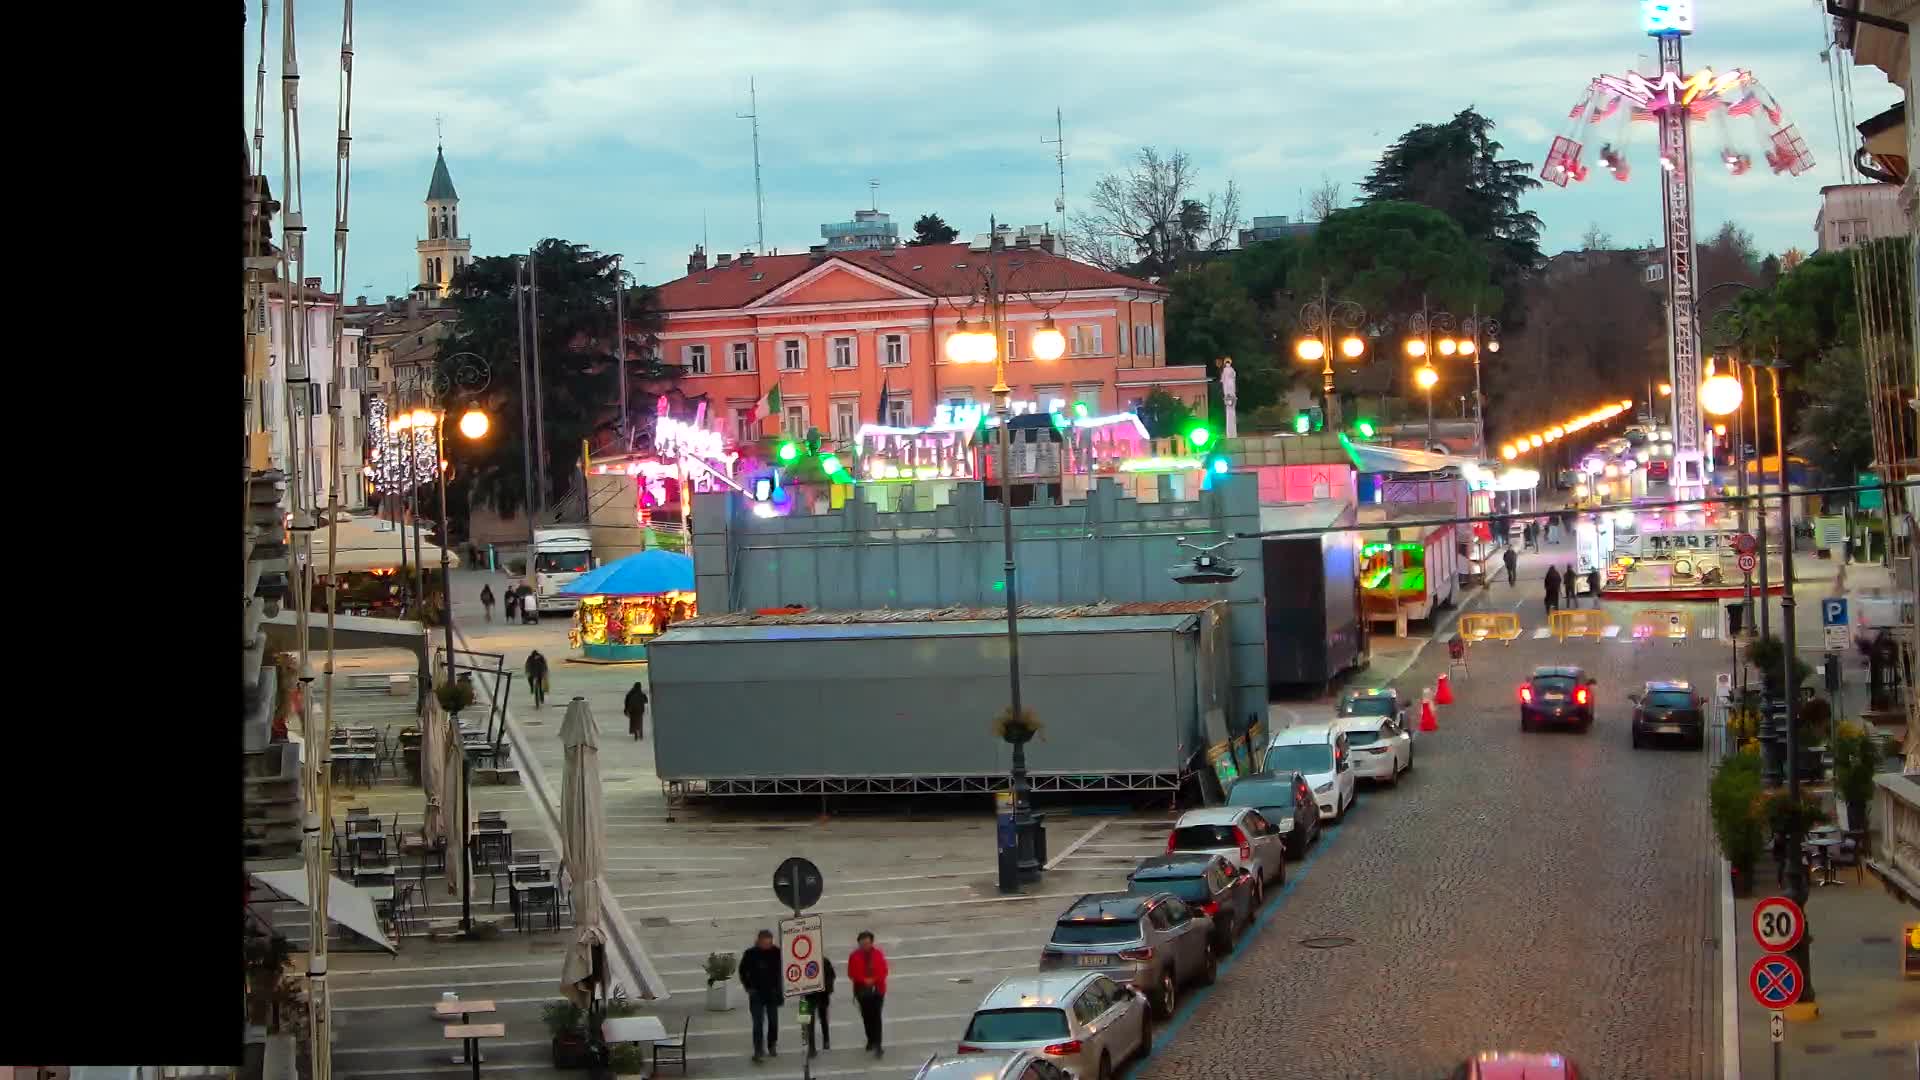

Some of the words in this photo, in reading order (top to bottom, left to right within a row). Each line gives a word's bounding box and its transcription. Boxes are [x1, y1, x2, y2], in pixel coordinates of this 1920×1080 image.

[1743, 558, 1753, 567] 20
[1828, 602, 1842, 622] P
[1762, 911, 1792, 938] 30
